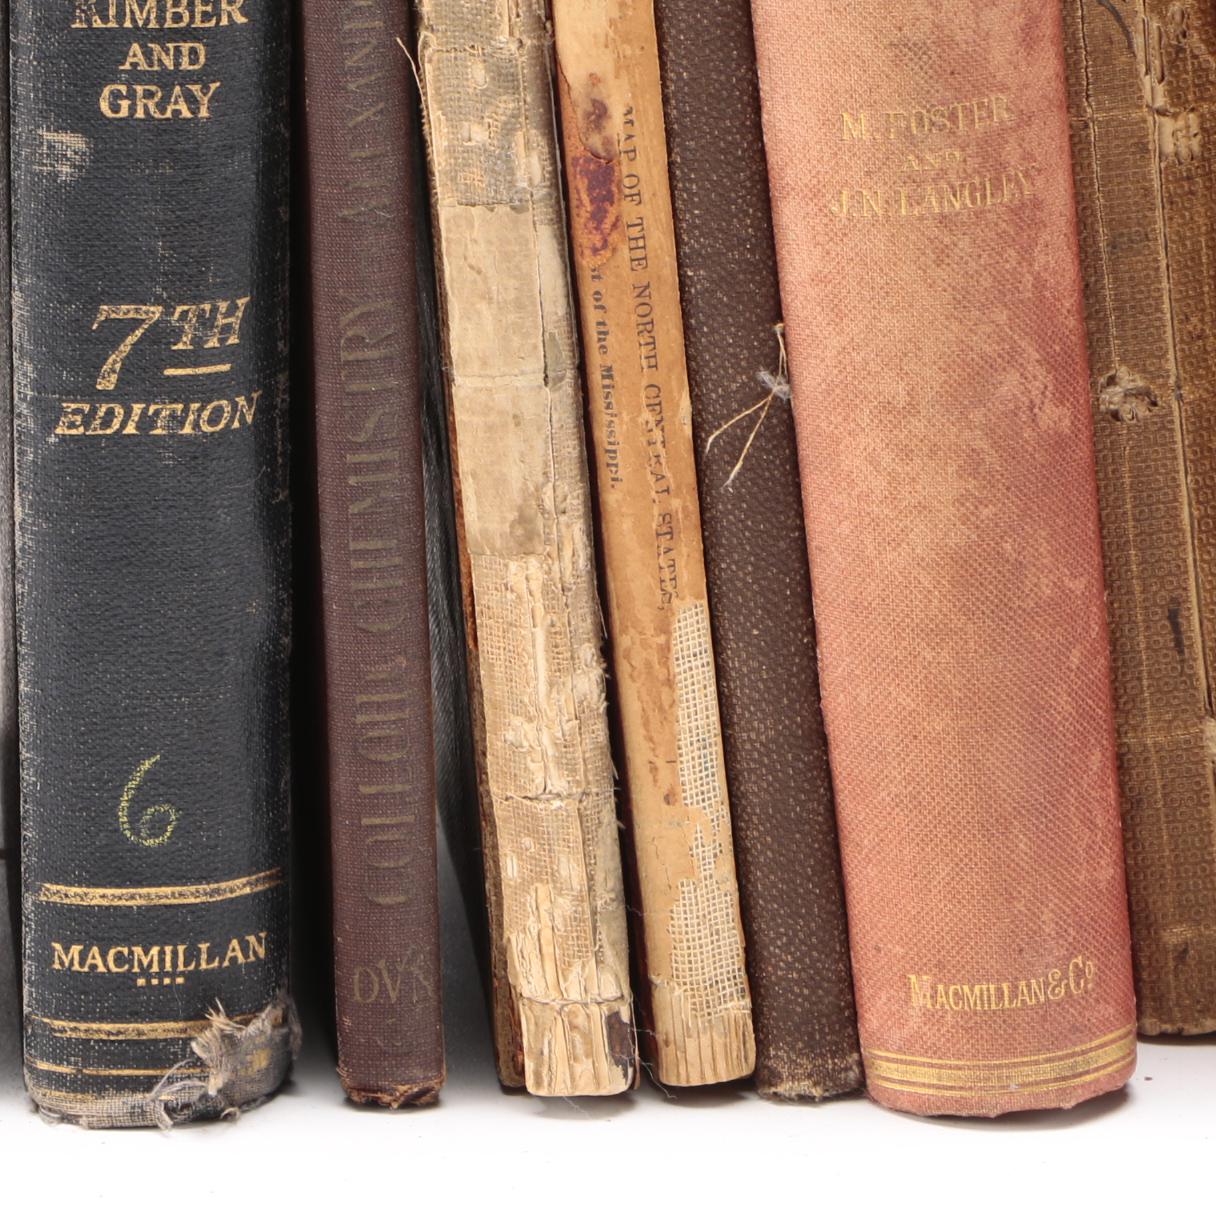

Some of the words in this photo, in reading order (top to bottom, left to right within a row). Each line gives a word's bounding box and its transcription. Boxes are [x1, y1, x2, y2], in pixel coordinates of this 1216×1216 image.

[118, 42, 206, 71] AND
[99, 82, 220, 119] GRAY
[622, 173, 642, 207] OF
[626, 217, 649, 272] THE
[592, 290, 609, 313] of
[595, 320, 611, 355] the
[632, 282, 659, 373] NORTH
[55, 389, 262, 436] EDITION
[118, 754, 179, 847] 6
[52, 932, 268, 973] MACMILLAN
